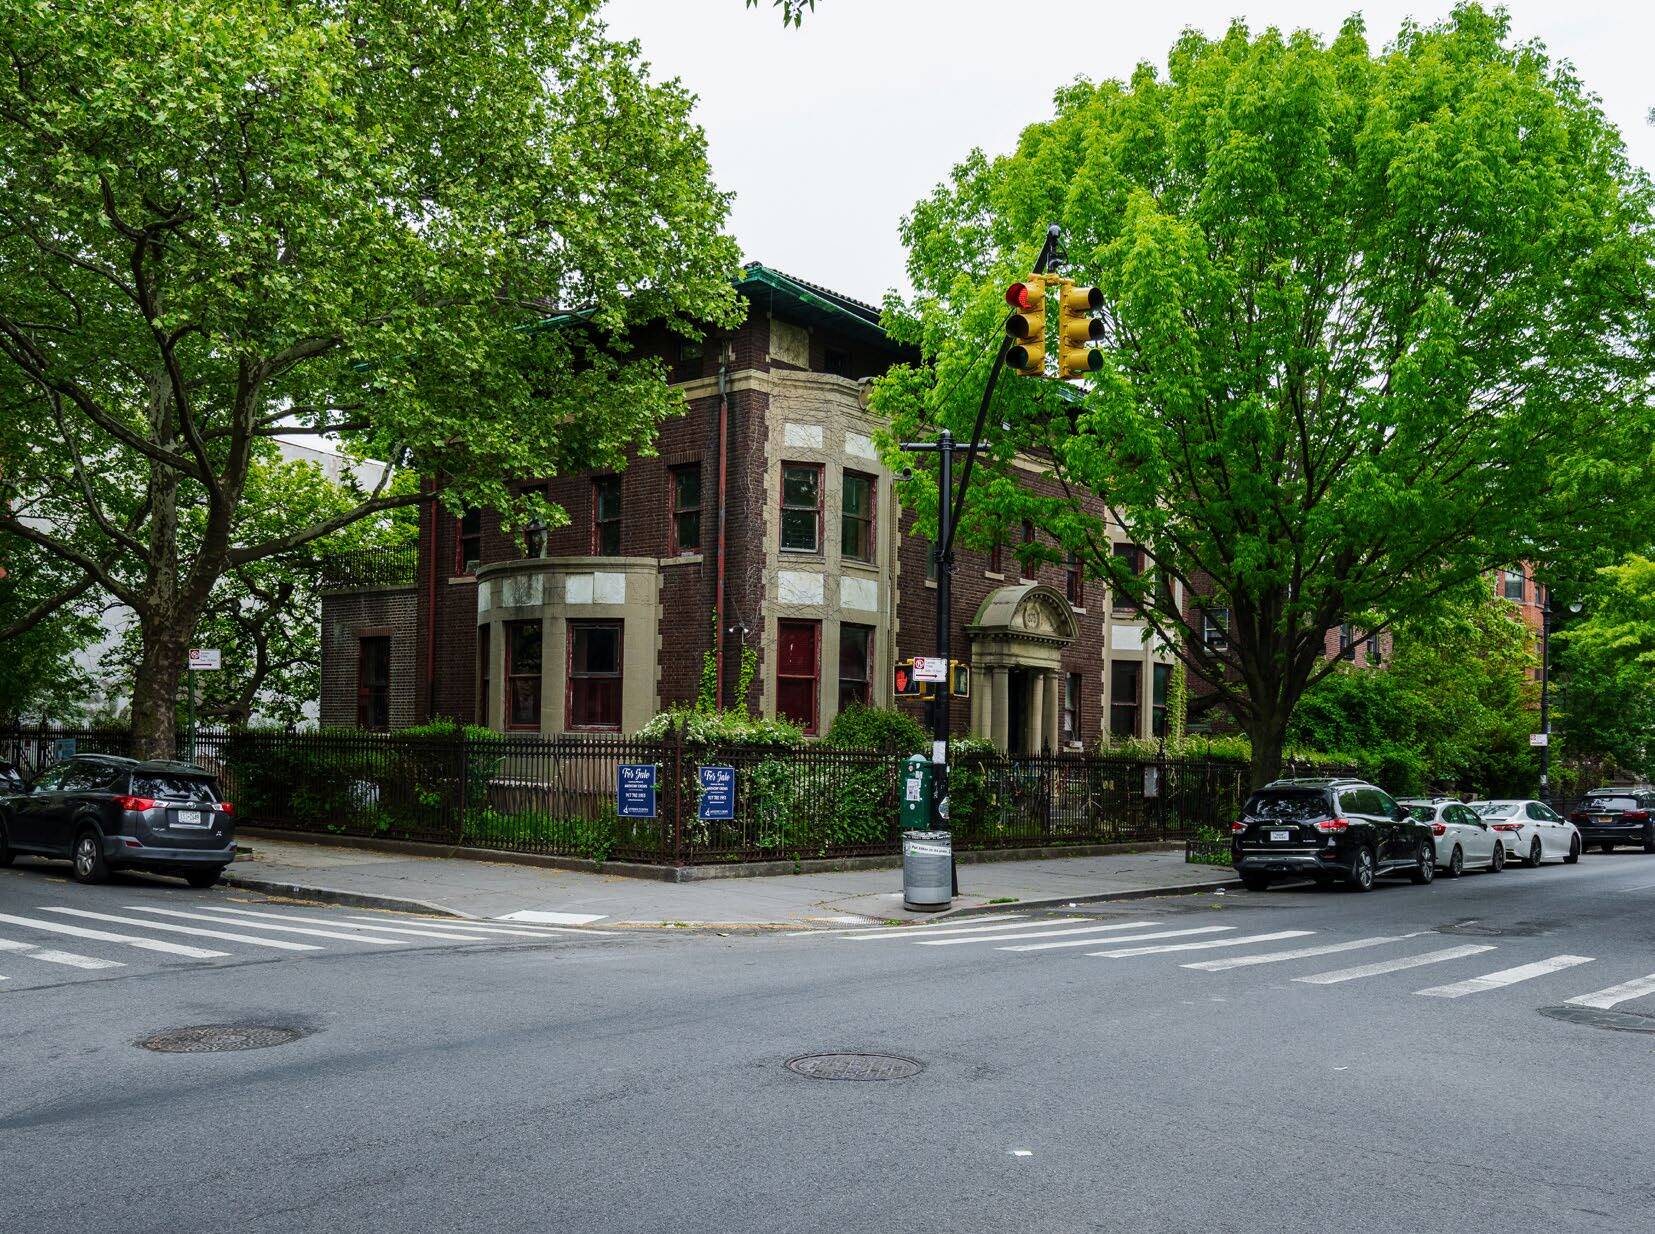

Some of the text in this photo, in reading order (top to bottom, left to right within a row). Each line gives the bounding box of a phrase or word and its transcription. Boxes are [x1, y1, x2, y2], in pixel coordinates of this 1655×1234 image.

[622, 768, 650, 780] For Sale
[704, 770, 731, 782] For Sale
